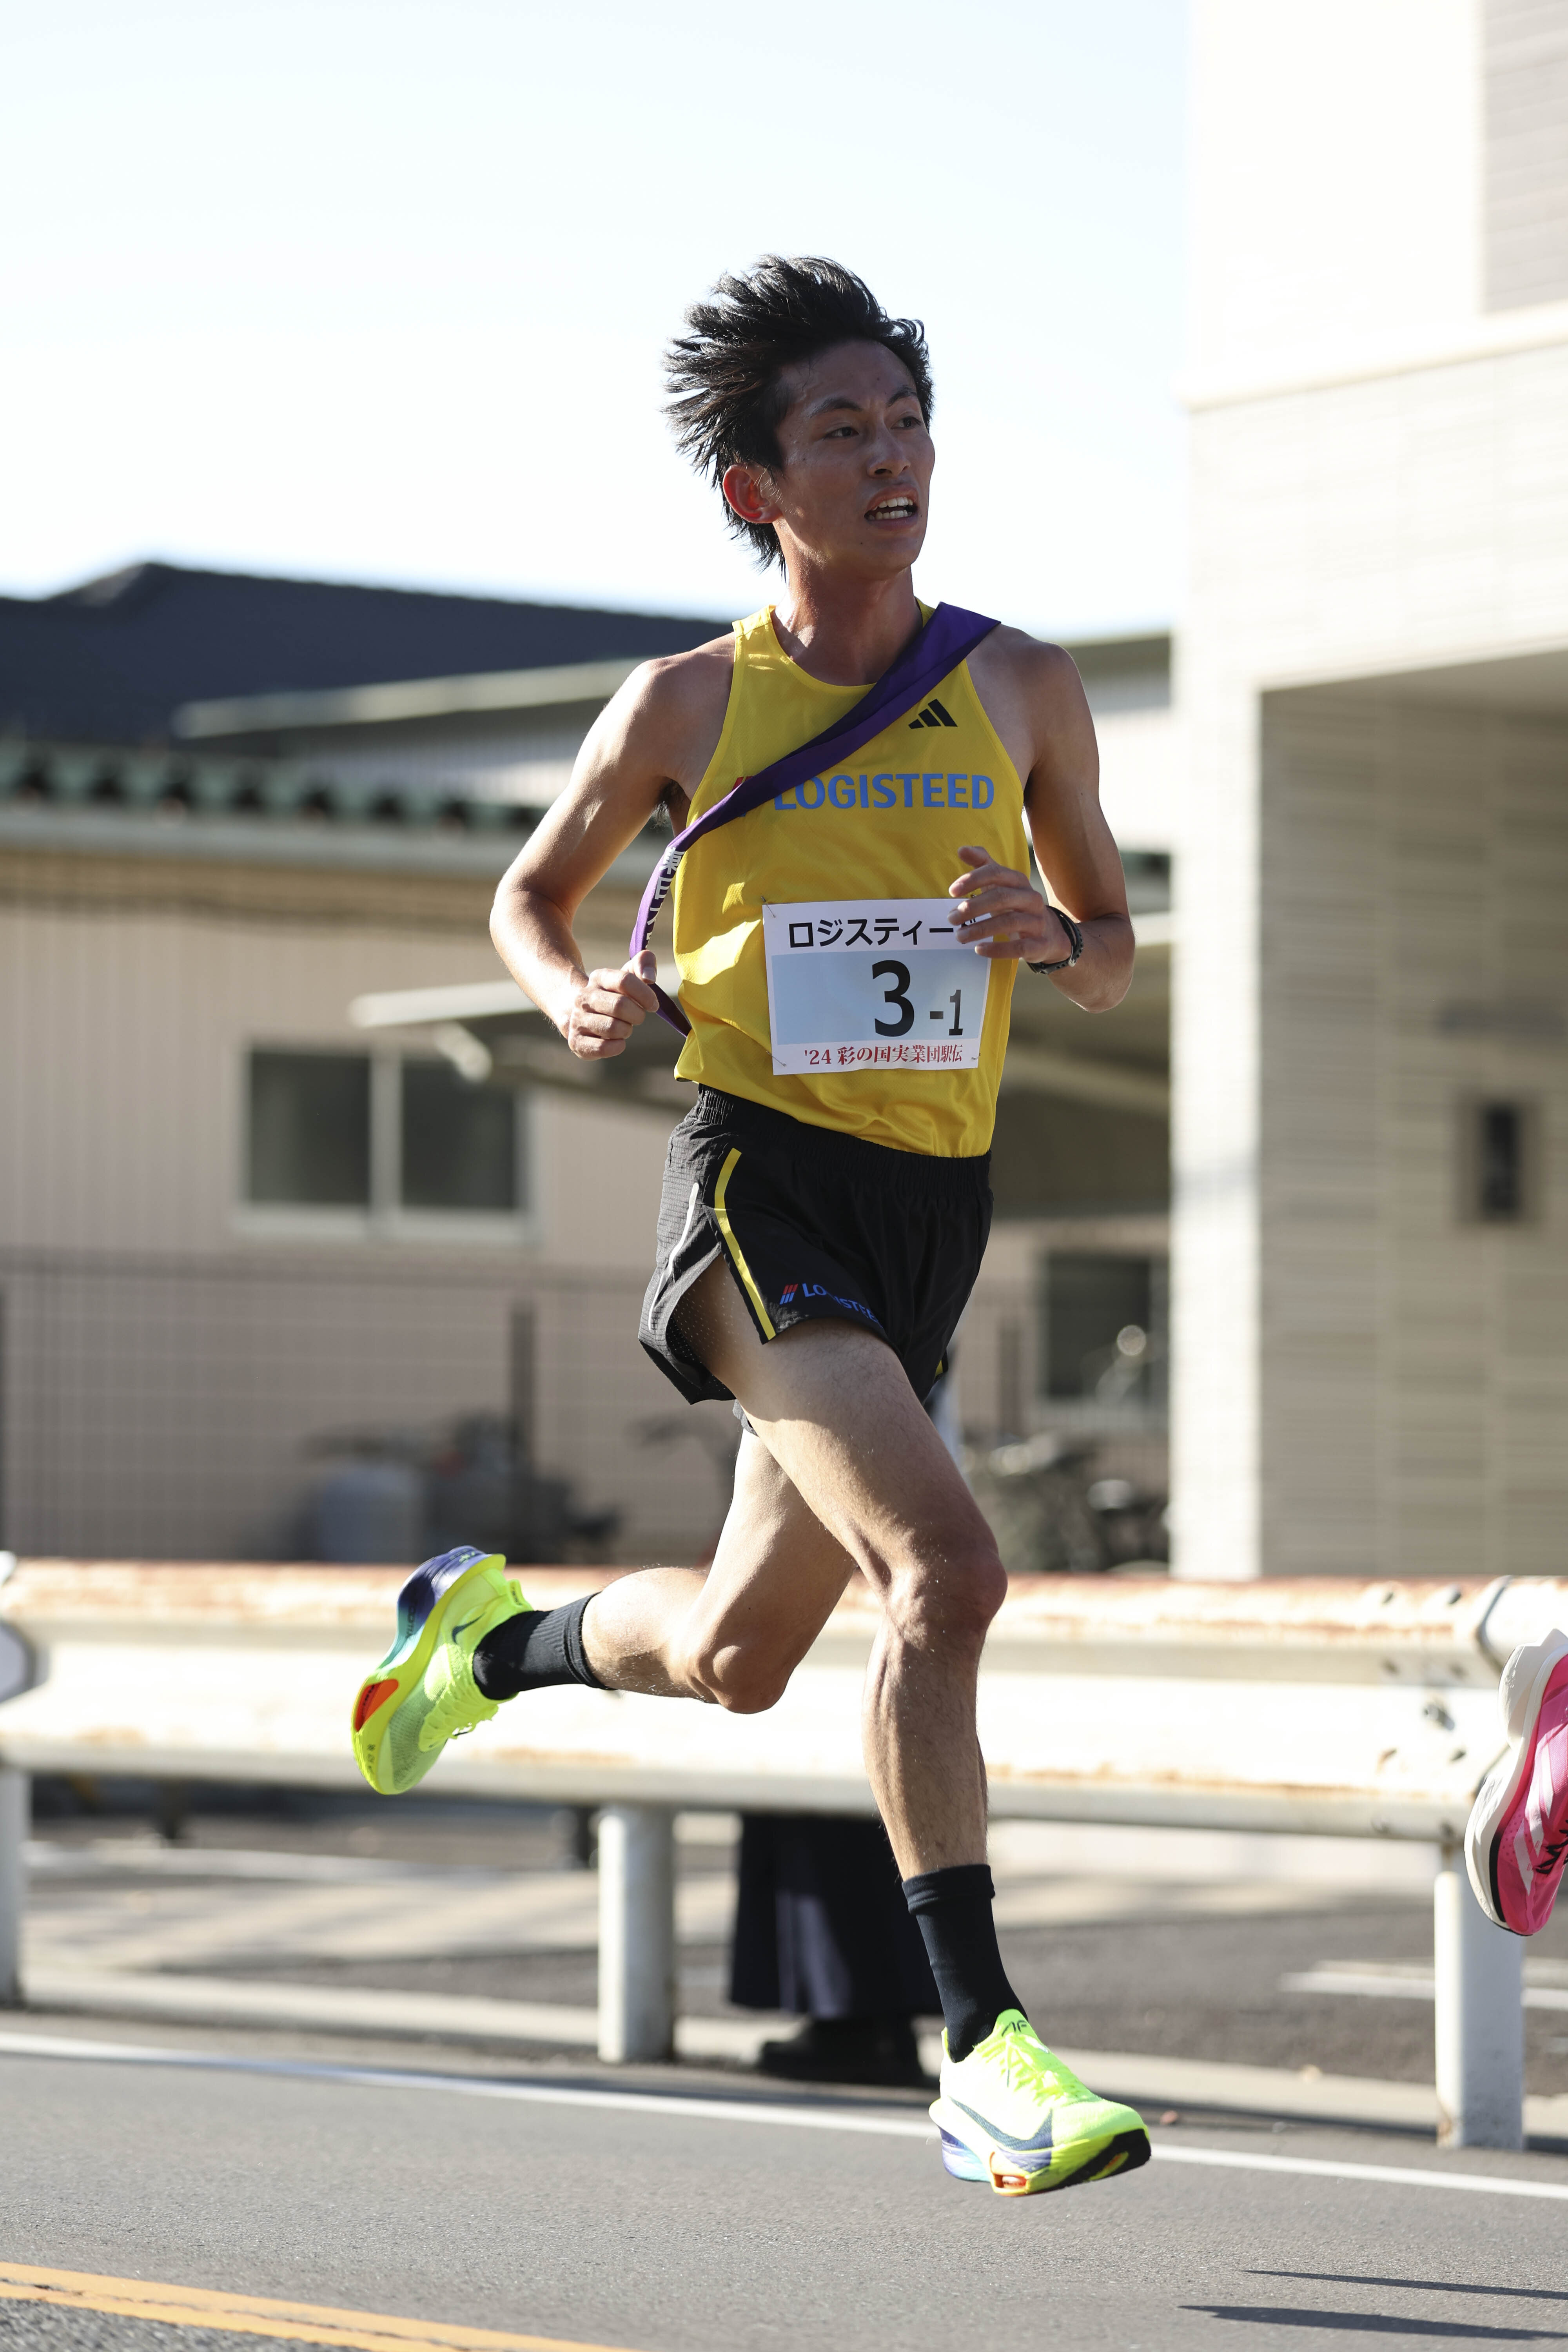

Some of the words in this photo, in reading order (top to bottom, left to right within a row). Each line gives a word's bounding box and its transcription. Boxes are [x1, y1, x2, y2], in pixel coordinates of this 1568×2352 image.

[789, 918, 976, 948] ロジスティー
[838, 1044, 962, 1065] 彩の国実業団駅伝
